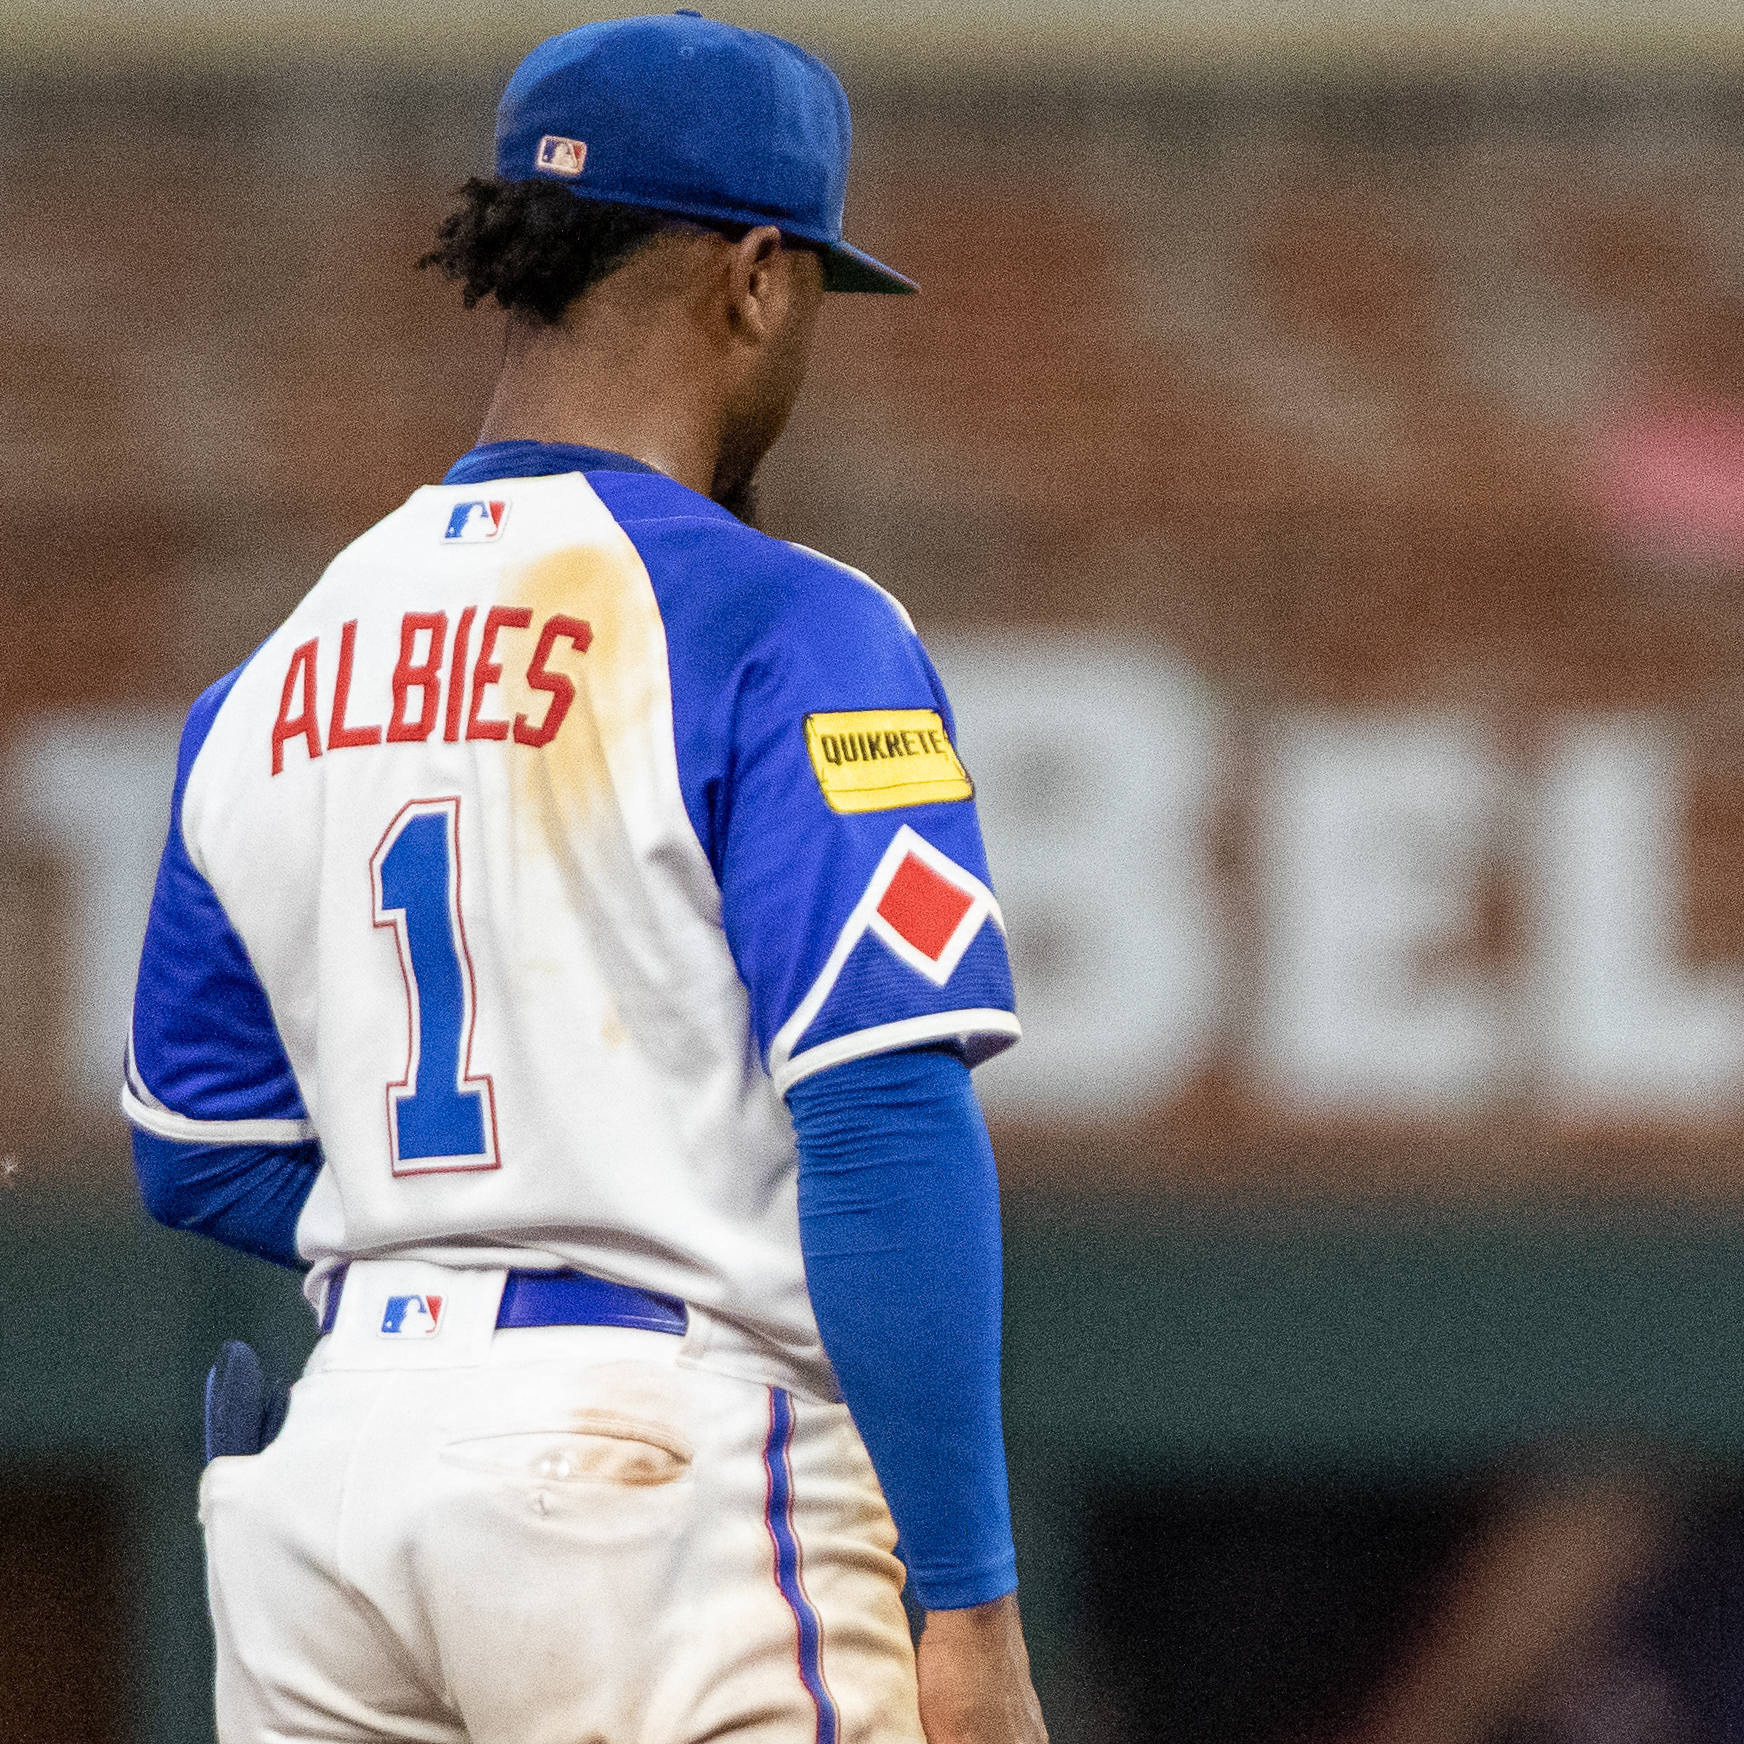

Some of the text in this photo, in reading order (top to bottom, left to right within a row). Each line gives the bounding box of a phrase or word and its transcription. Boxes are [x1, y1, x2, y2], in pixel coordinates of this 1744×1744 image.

[271, 604, 595, 777] ALBIES
[820, 730, 949, 766] QUIKRETE
[369, 796, 502, 1178] 1
